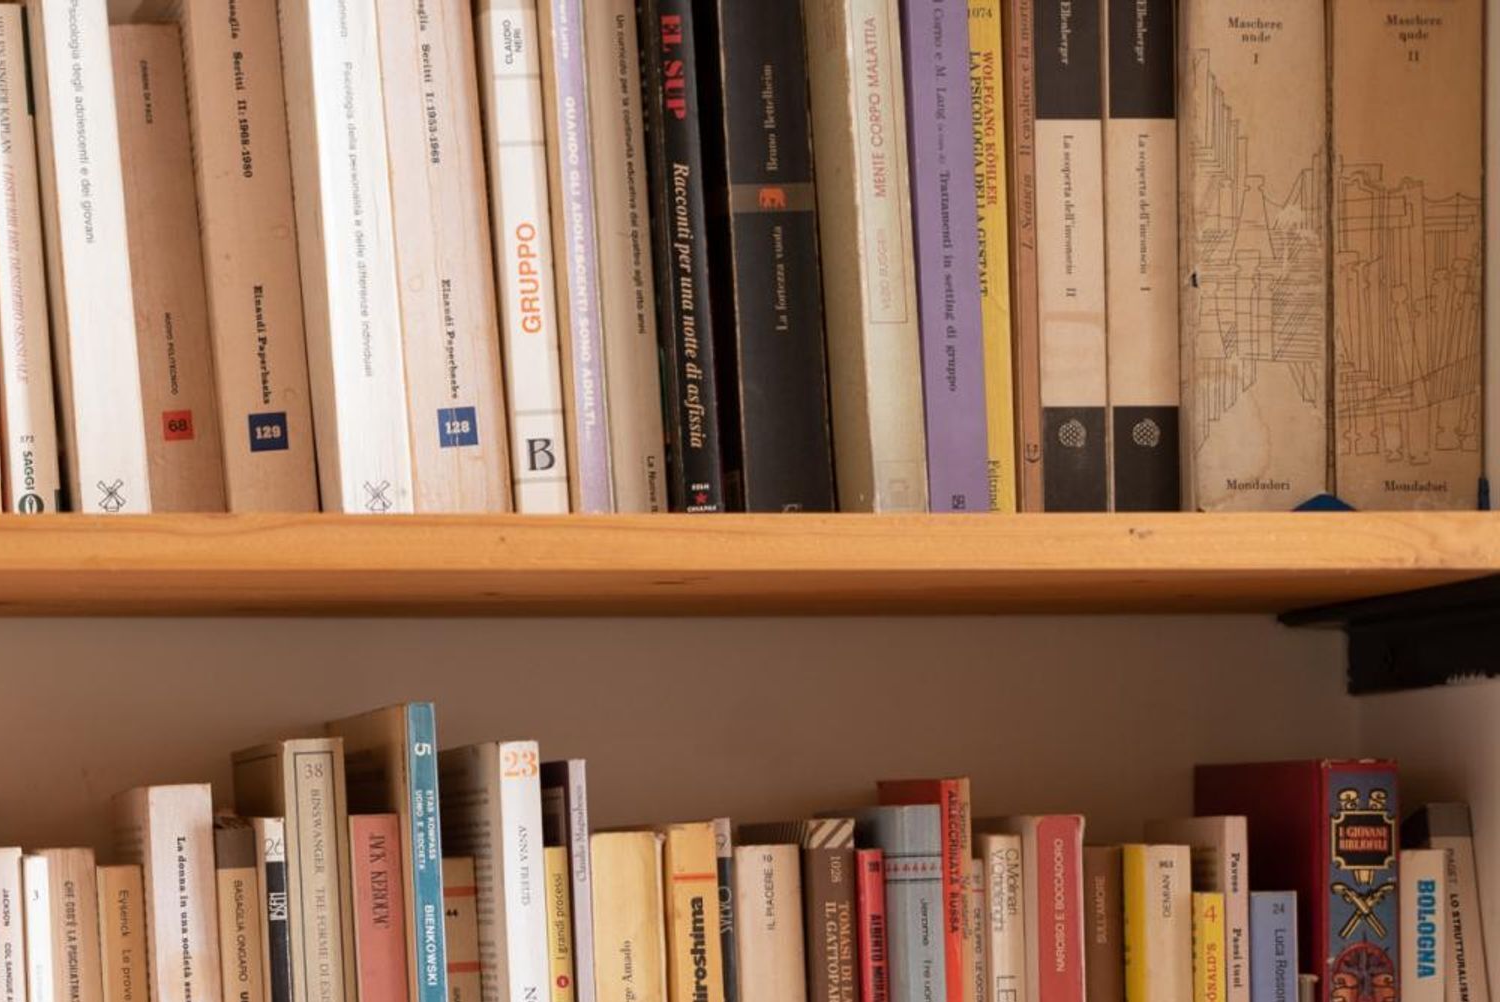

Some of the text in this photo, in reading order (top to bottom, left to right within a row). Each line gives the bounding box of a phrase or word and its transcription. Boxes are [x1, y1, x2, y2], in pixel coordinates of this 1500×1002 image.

[1228, 19, 1283, 30] Maschere
[1385, 15, 1443, 26] Maschere
[661, 15, 685, 119] EL SUP
[1136, 134, 1149, 147] La
[1136, 152, 1149, 196] scoperta
[1137, 200, 1150, 274] dell'inconscio
[515, 223, 541, 333] GRUPPO
[939, 170, 958, 391] Trattamenti in setting di gruppo
[671, 164, 705, 448] Racconti per una notte di asfissia
[253, 286, 271, 404] Einaudi Paperbacks
[446, 421, 470, 433] 128
[22, 451, 35, 490] SAGGI
[1226, 480, 1291, 492] Mondadori
[1383, 481, 1448, 492] Mondadori
[415, 743, 430, 756] 5
[505, 752, 538, 777] 23
[177, 837, 187, 852] La
[178, 856, 189, 891] donna
[830, 856, 841, 882] 1028
[180, 896, 189, 907] in
[826, 902, 837, 917] IL
[1450, 894, 1460, 908] LO
[180, 912, 191, 934] una
[839, 902, 851, 960] TOMASI
[1417, 881, 1435, 978] BOLOGNA
[425, 905, 437, 986] BIENKOWSKI
[841, 965, 852, 980] DI
